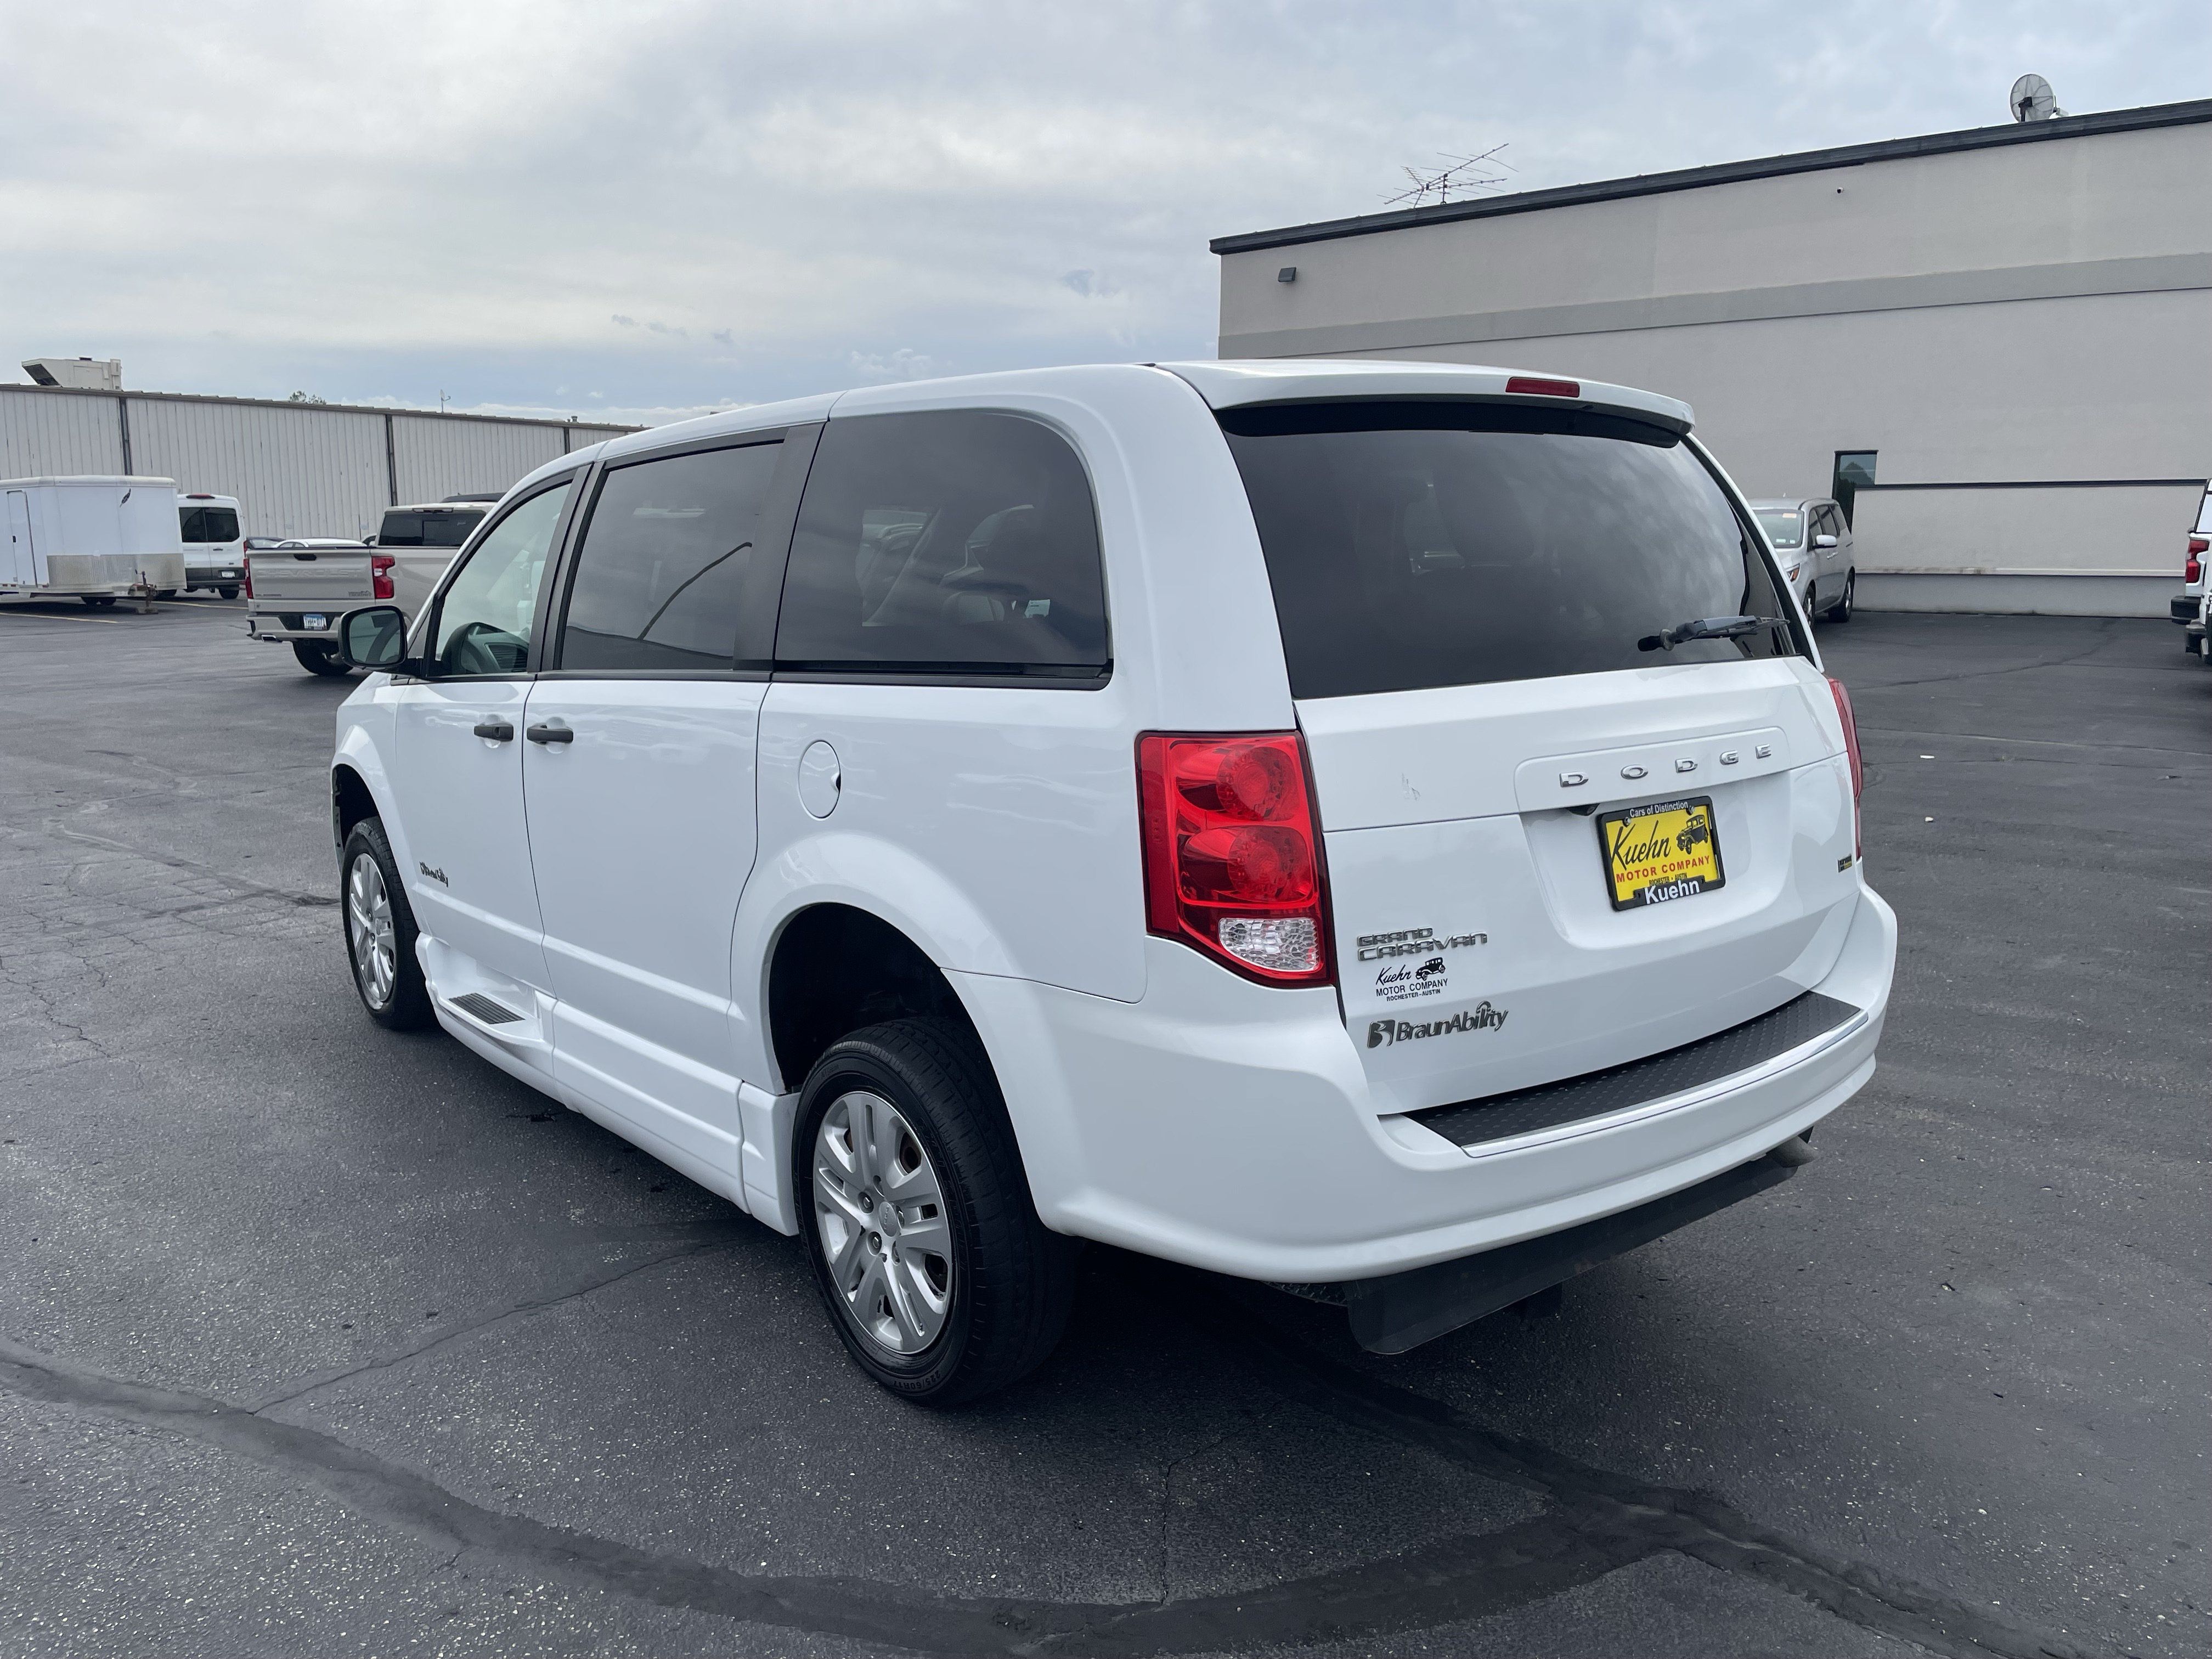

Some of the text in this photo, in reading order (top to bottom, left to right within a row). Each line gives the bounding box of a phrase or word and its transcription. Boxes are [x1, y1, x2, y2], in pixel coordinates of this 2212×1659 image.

[1559, 743, 1771, 788] DODGE
[1629, 801, 1689, 818] Cars of Distinction
[1612, 820, 1671, 871] Kuehn
[1616, 855, 1710, 883] MOTOR COMPANY
[1644, 879, 1700, 905] Kuehn
[1357, 927, 1433, 946] GRAND
[1357, 931, 1488, 961] CARAVAN
[1375, 964, 1412, 986] Kuehn
[1376, 978, 1448, 997] MOTOR COMPANY
[1396, 1001, 1509, 1042] BraunAbility
